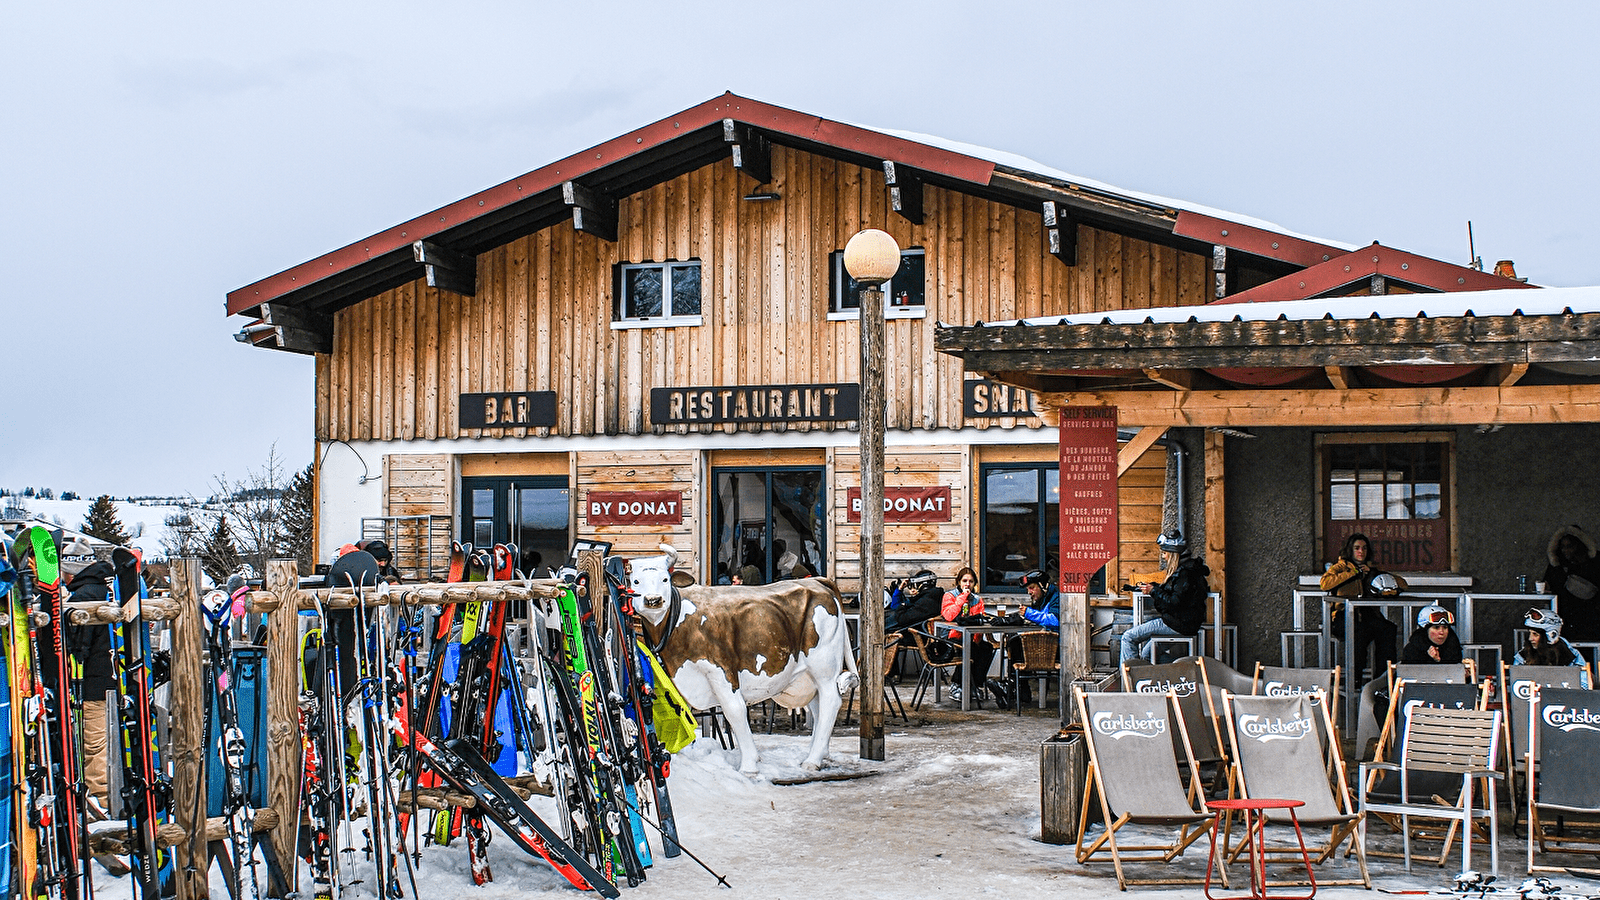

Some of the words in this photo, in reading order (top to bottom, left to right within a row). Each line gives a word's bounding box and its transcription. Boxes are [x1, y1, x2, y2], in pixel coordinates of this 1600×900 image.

[669, 388, 840, 420] RESTAURANT
[974, 383, 1028, 413] SNA
[485, 396, 530, 424] BAR
[1063, 408, 1080, 419] SELF
[1083, 408, 1113, 419] SERVICE
[1074, 490, 1103, 498] GAUFRES
[591, 501, 612, 515] BY
[618, 501, 677, 515] DONAT
[852, 498, 861, 512] B
[884, 497, 945, 512] DONAT
[1066, 551, 1081, 559] SALÉ
[1090, 551, 1110, 559] SUCRÉ
[1372, 540, 1433, 565] ERDITS
[1063, 572, 1081, 584] SELF
[1136, 677, 1197, 697] Carlsberg
[1093, 711, 1166, 738] Carlsberg
[1239, 712, 1312, 741] Carlsberg
